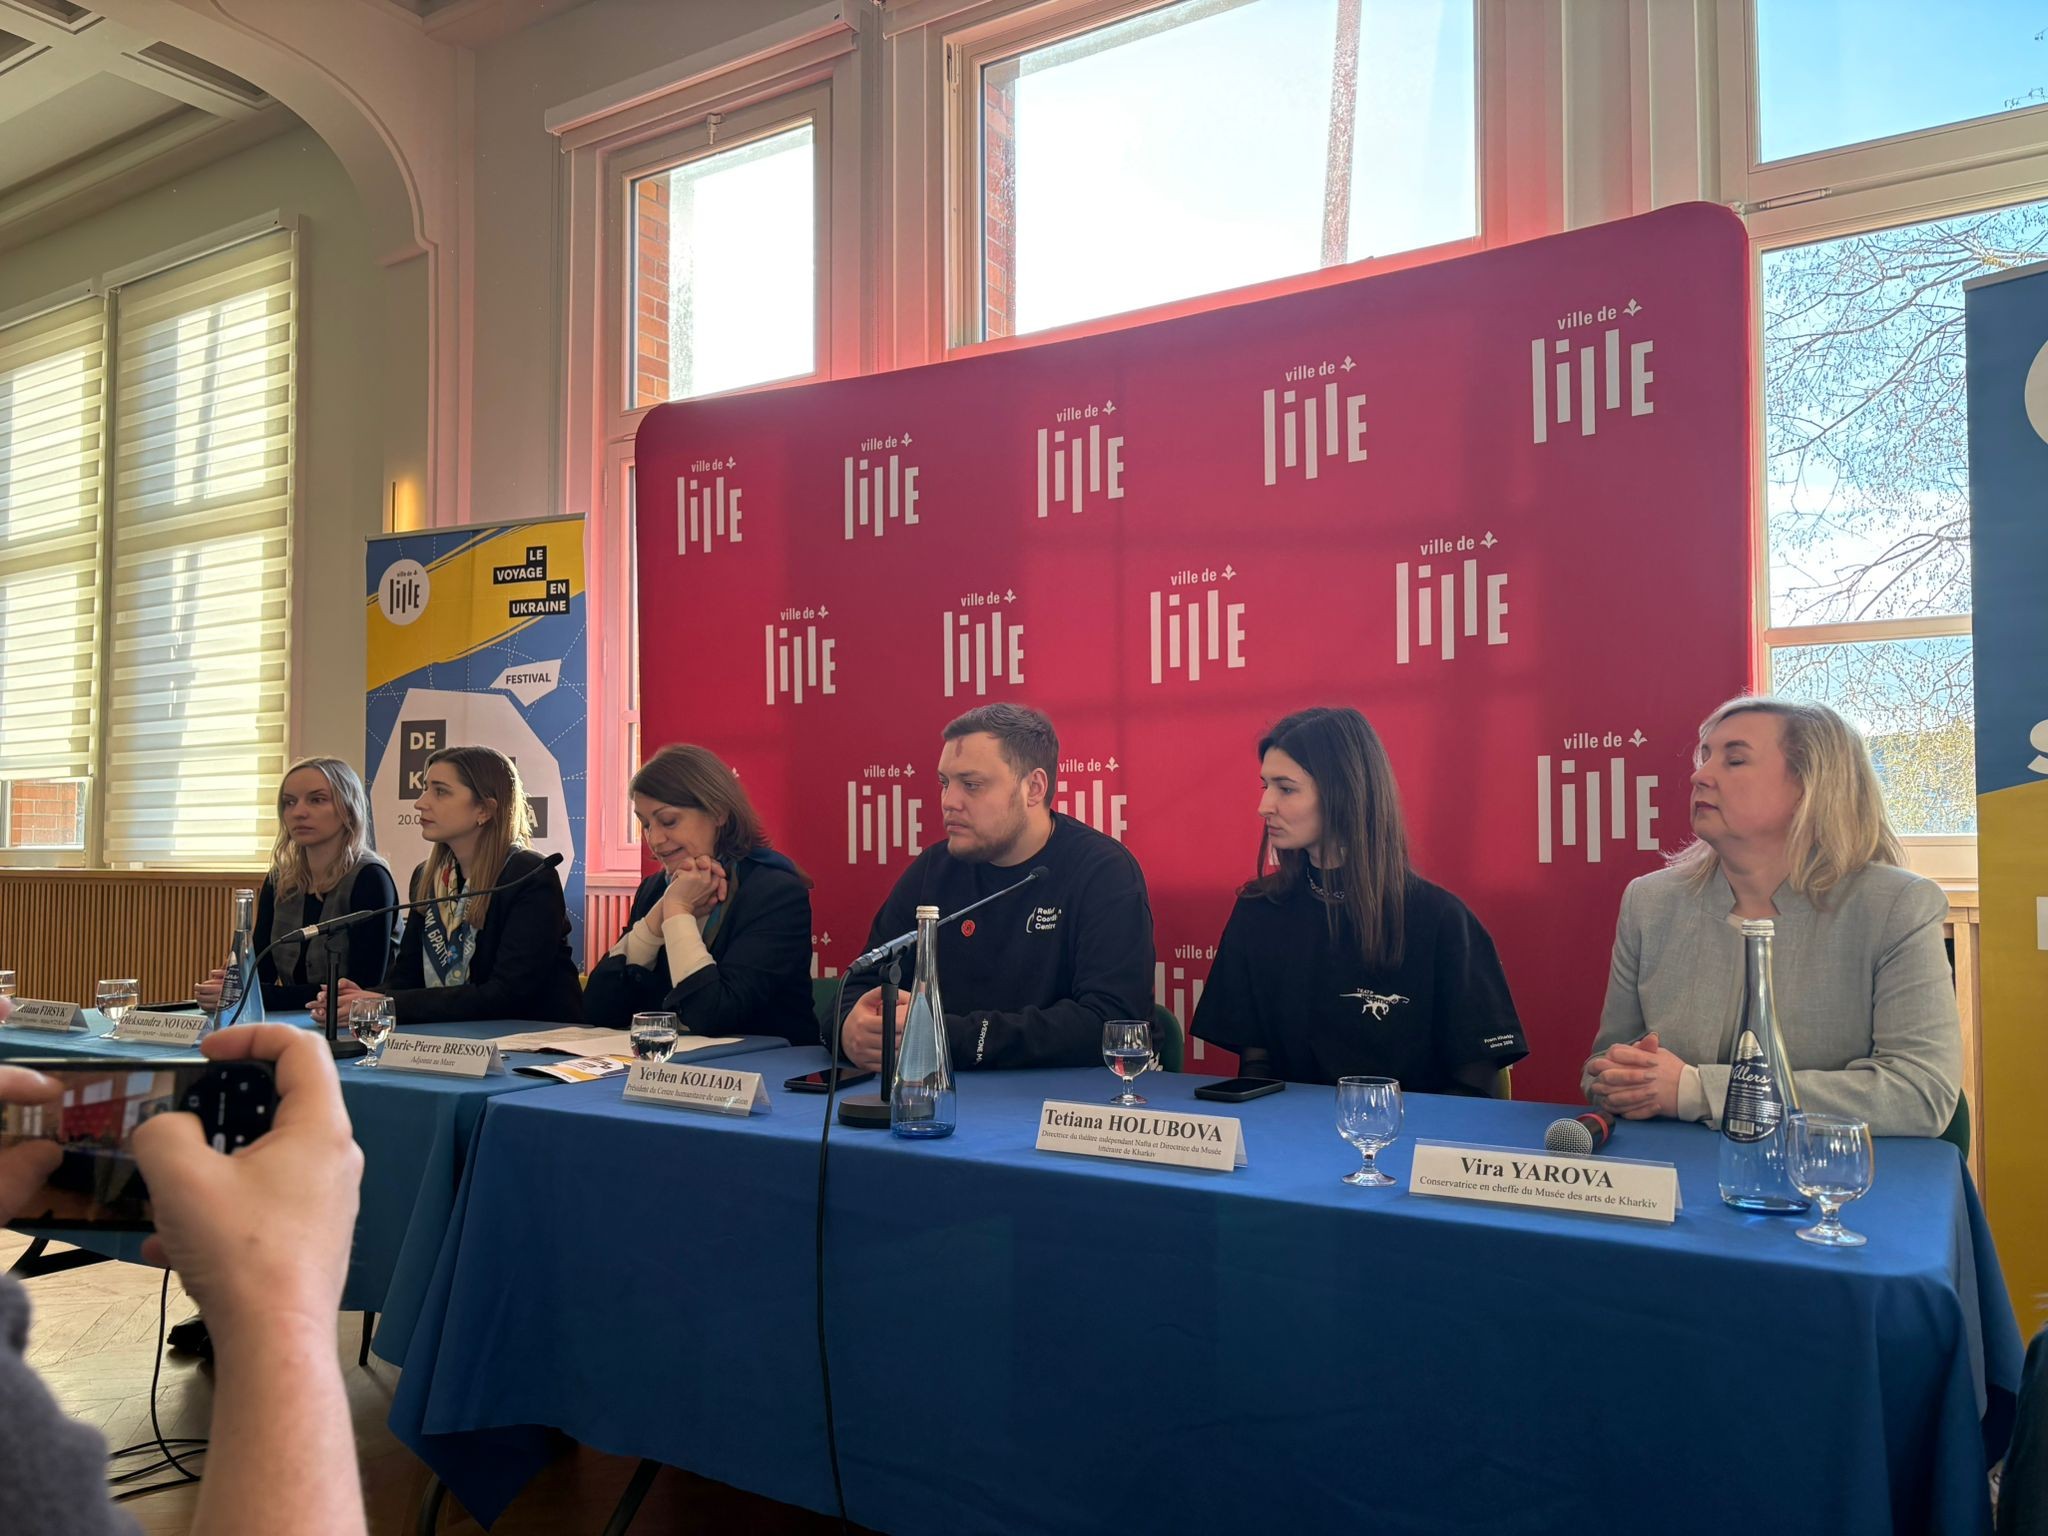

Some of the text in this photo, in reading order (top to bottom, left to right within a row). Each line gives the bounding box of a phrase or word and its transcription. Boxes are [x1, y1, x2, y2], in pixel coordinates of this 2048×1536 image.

[1556, 305, 1617, 330] ville de
[1285, 361, 1336, 382] ville de
[1056, 403, 1099, 423] ville de
[860, 435, 898, 451] ville de
[691, 458, 724, 473] ville de
[1420, 535, 1476, 556] ville de
[529, 549, 544, 561] LE
[496, 566, 543, 581] VOYAGE
[1170, 568, 1218, 586] ville de
[549, 582, 566, 595] EN
[512, 600, 567, 615] UKRAINE
[960, 591, 1000, 607] ville de
[780, 606, 815, 621] ville de
[505, 672, 552, 685] FESTIVAL
[409, 731, 436, 750] DE
[1563, 731, 1623, 750] ville de
[863, 764, 900, 778] ville de
[1058, 758, 1102, 773] ville de
[1174, 944, 1203, 960] ville
[385, 1038, 494, 1057] Marie-Pierre BRESSON
[639, 1066, 743, 1091] Yevhen KOLIADA
[1045, 1109, 1223, 1142] Tetiana HOLUBOVA
[1041, 1129, 1069, 1139] Directrice
[1069, 1132, 1078, 1140] du
[1191, 1145, 1200, 1153] du
[1123, 1147, 1131, 1155] de
[1461, 1157, 1614, 1189] Vira YAROVA
[1419, 1175, 1658, 1209] Conservatrice en cheffe du Musée des arts de Kharkiv
